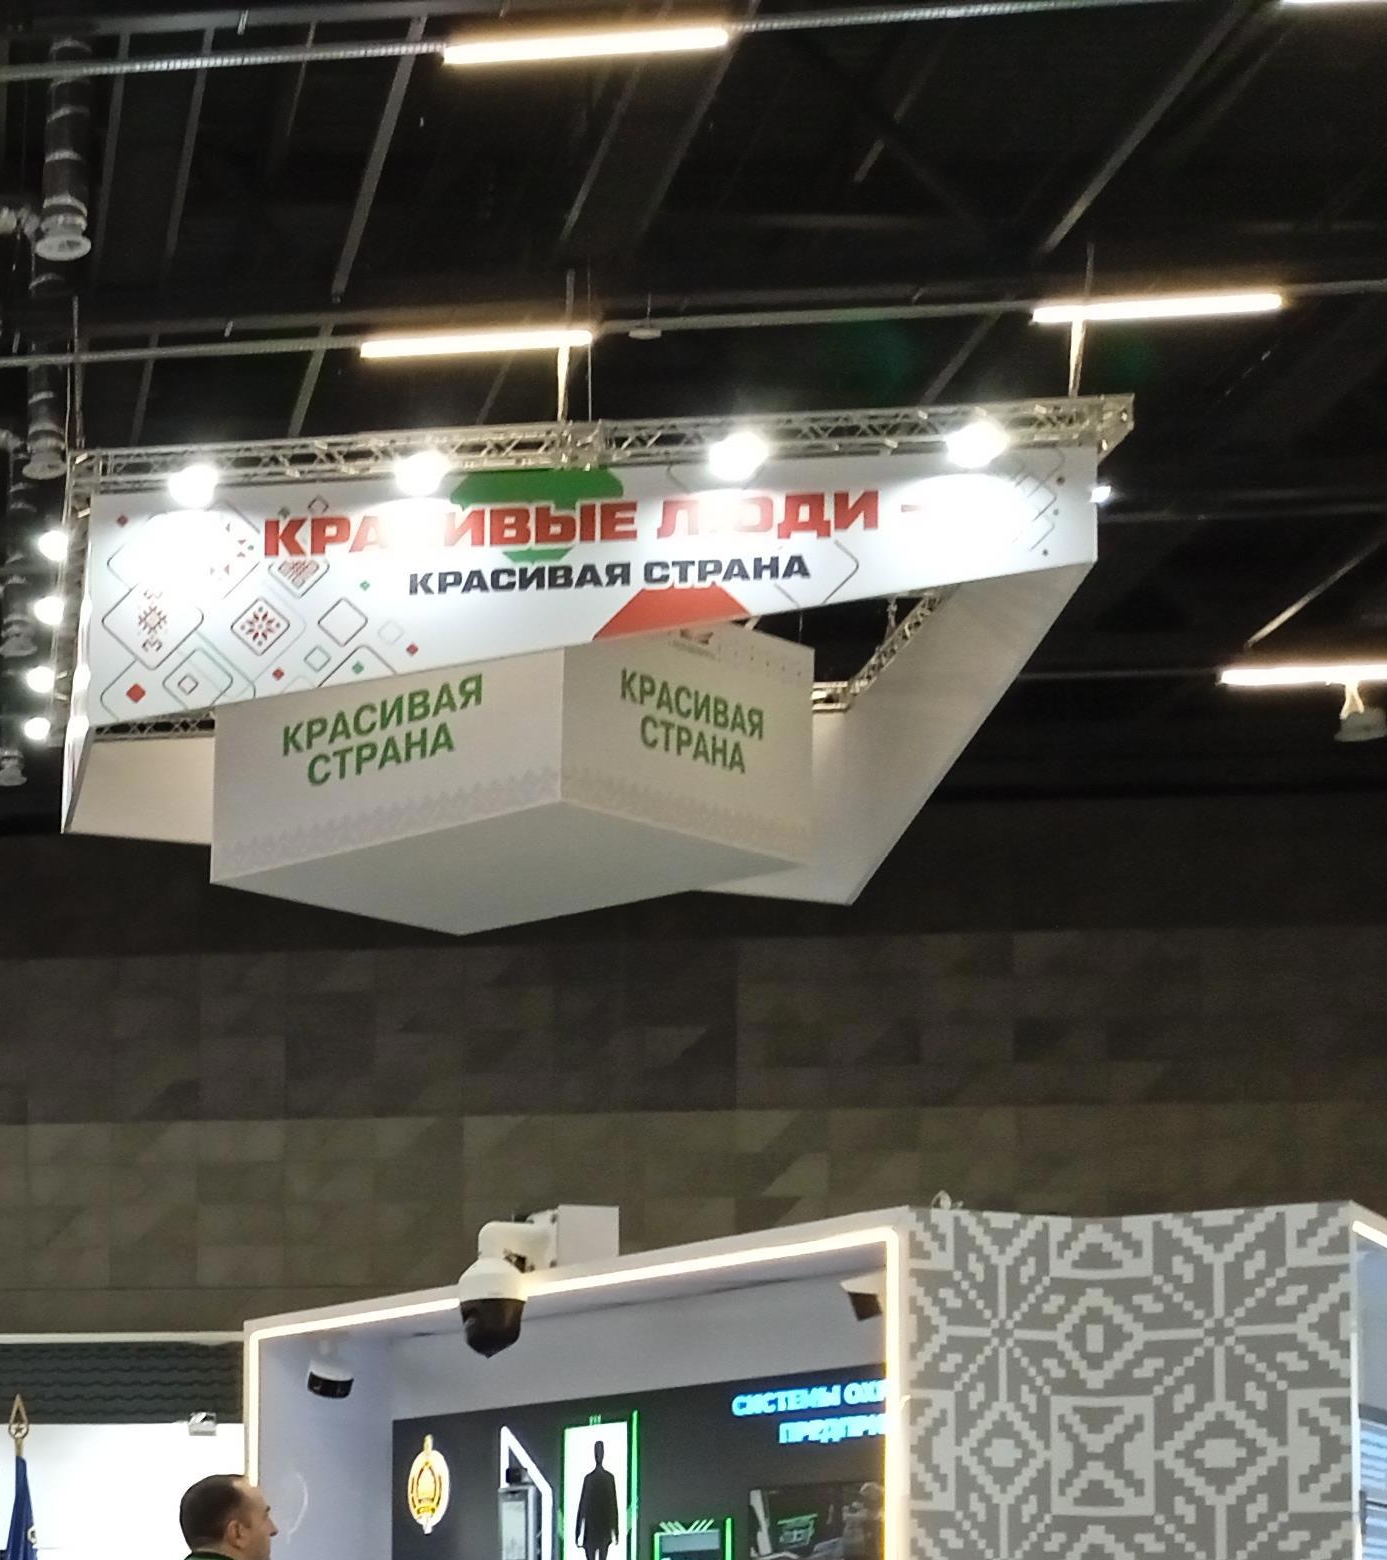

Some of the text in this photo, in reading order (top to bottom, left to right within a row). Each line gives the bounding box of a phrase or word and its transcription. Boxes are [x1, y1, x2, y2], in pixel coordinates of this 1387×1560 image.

[263, 501, 638, 558] КРАИВЫЕ
[408, 554, 811, 596] КРАСИВАЯ СТРАНА
[282, 673, 484, 756] КРАСИВАЯ
[620, 667, 765, 741] КРАСИВАЯ
[307, 721, 456, 787] СТРАНА
[640, 716, 747, 775] СТРАНА
[731, 1385, 841, 1416] СИСТЕМЫ
